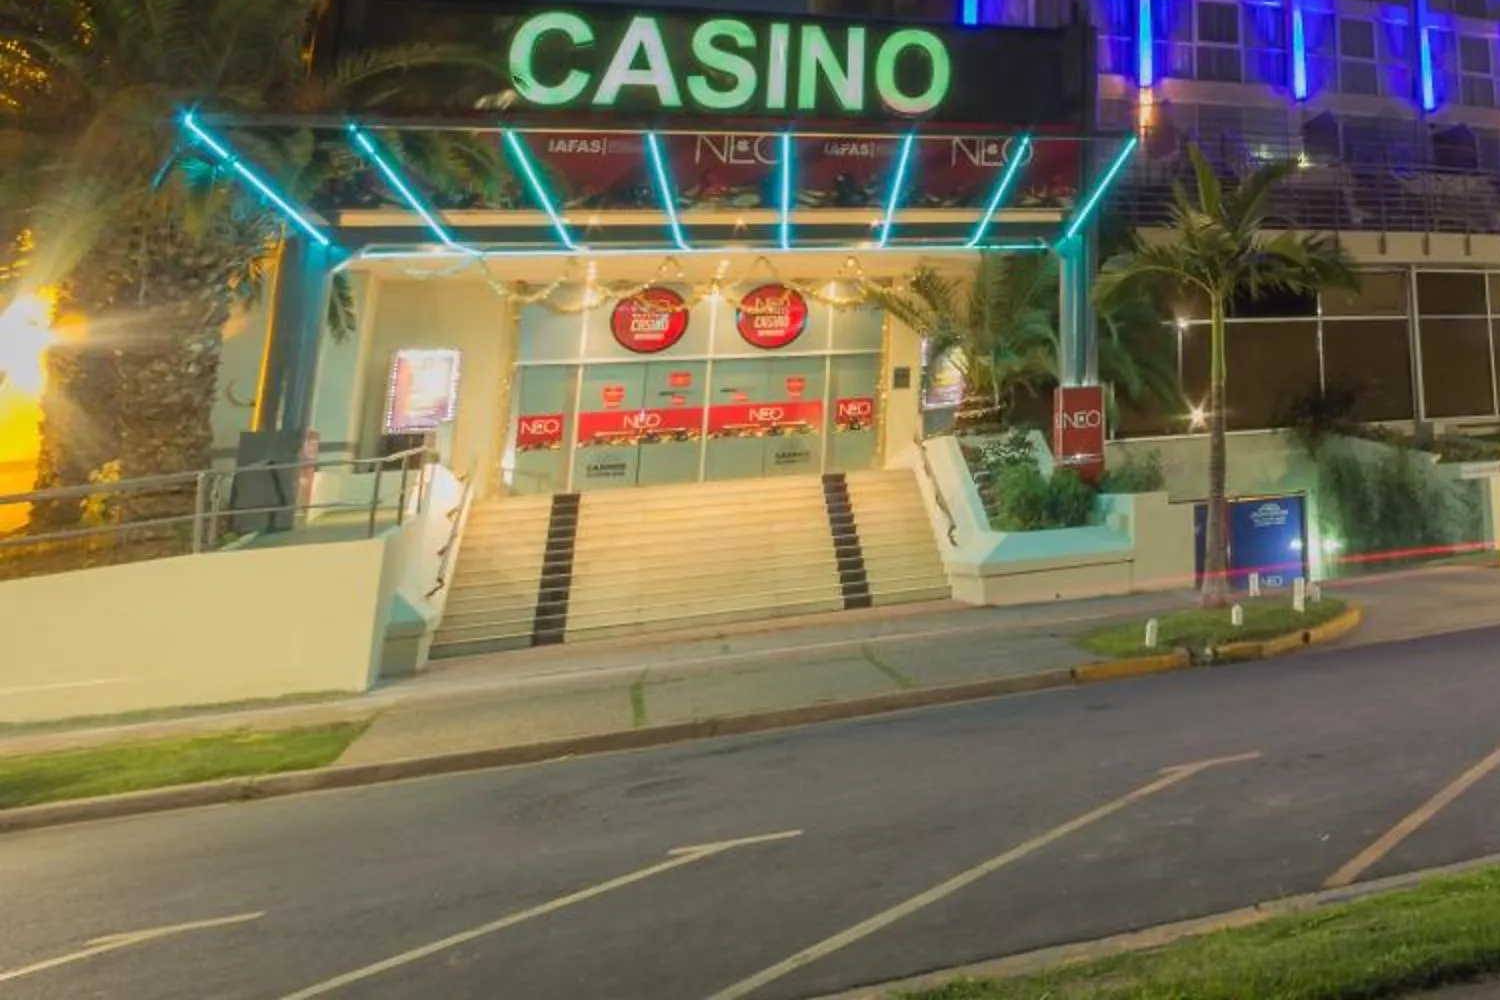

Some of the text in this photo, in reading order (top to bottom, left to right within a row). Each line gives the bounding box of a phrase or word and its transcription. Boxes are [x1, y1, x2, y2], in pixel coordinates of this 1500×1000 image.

[508, 11, 951, 114] CASINO
[695, 134, 784, 165] NEO
[951, 137, 1034, 168] NEO
[749, 407, 785, 421] NEO
[839, 401, 871, 416] NEO
[520, 419, 561, 435] NEO
[623, 412, 661, 429] NEO
[1062, 409, 1101, 430] NEO
